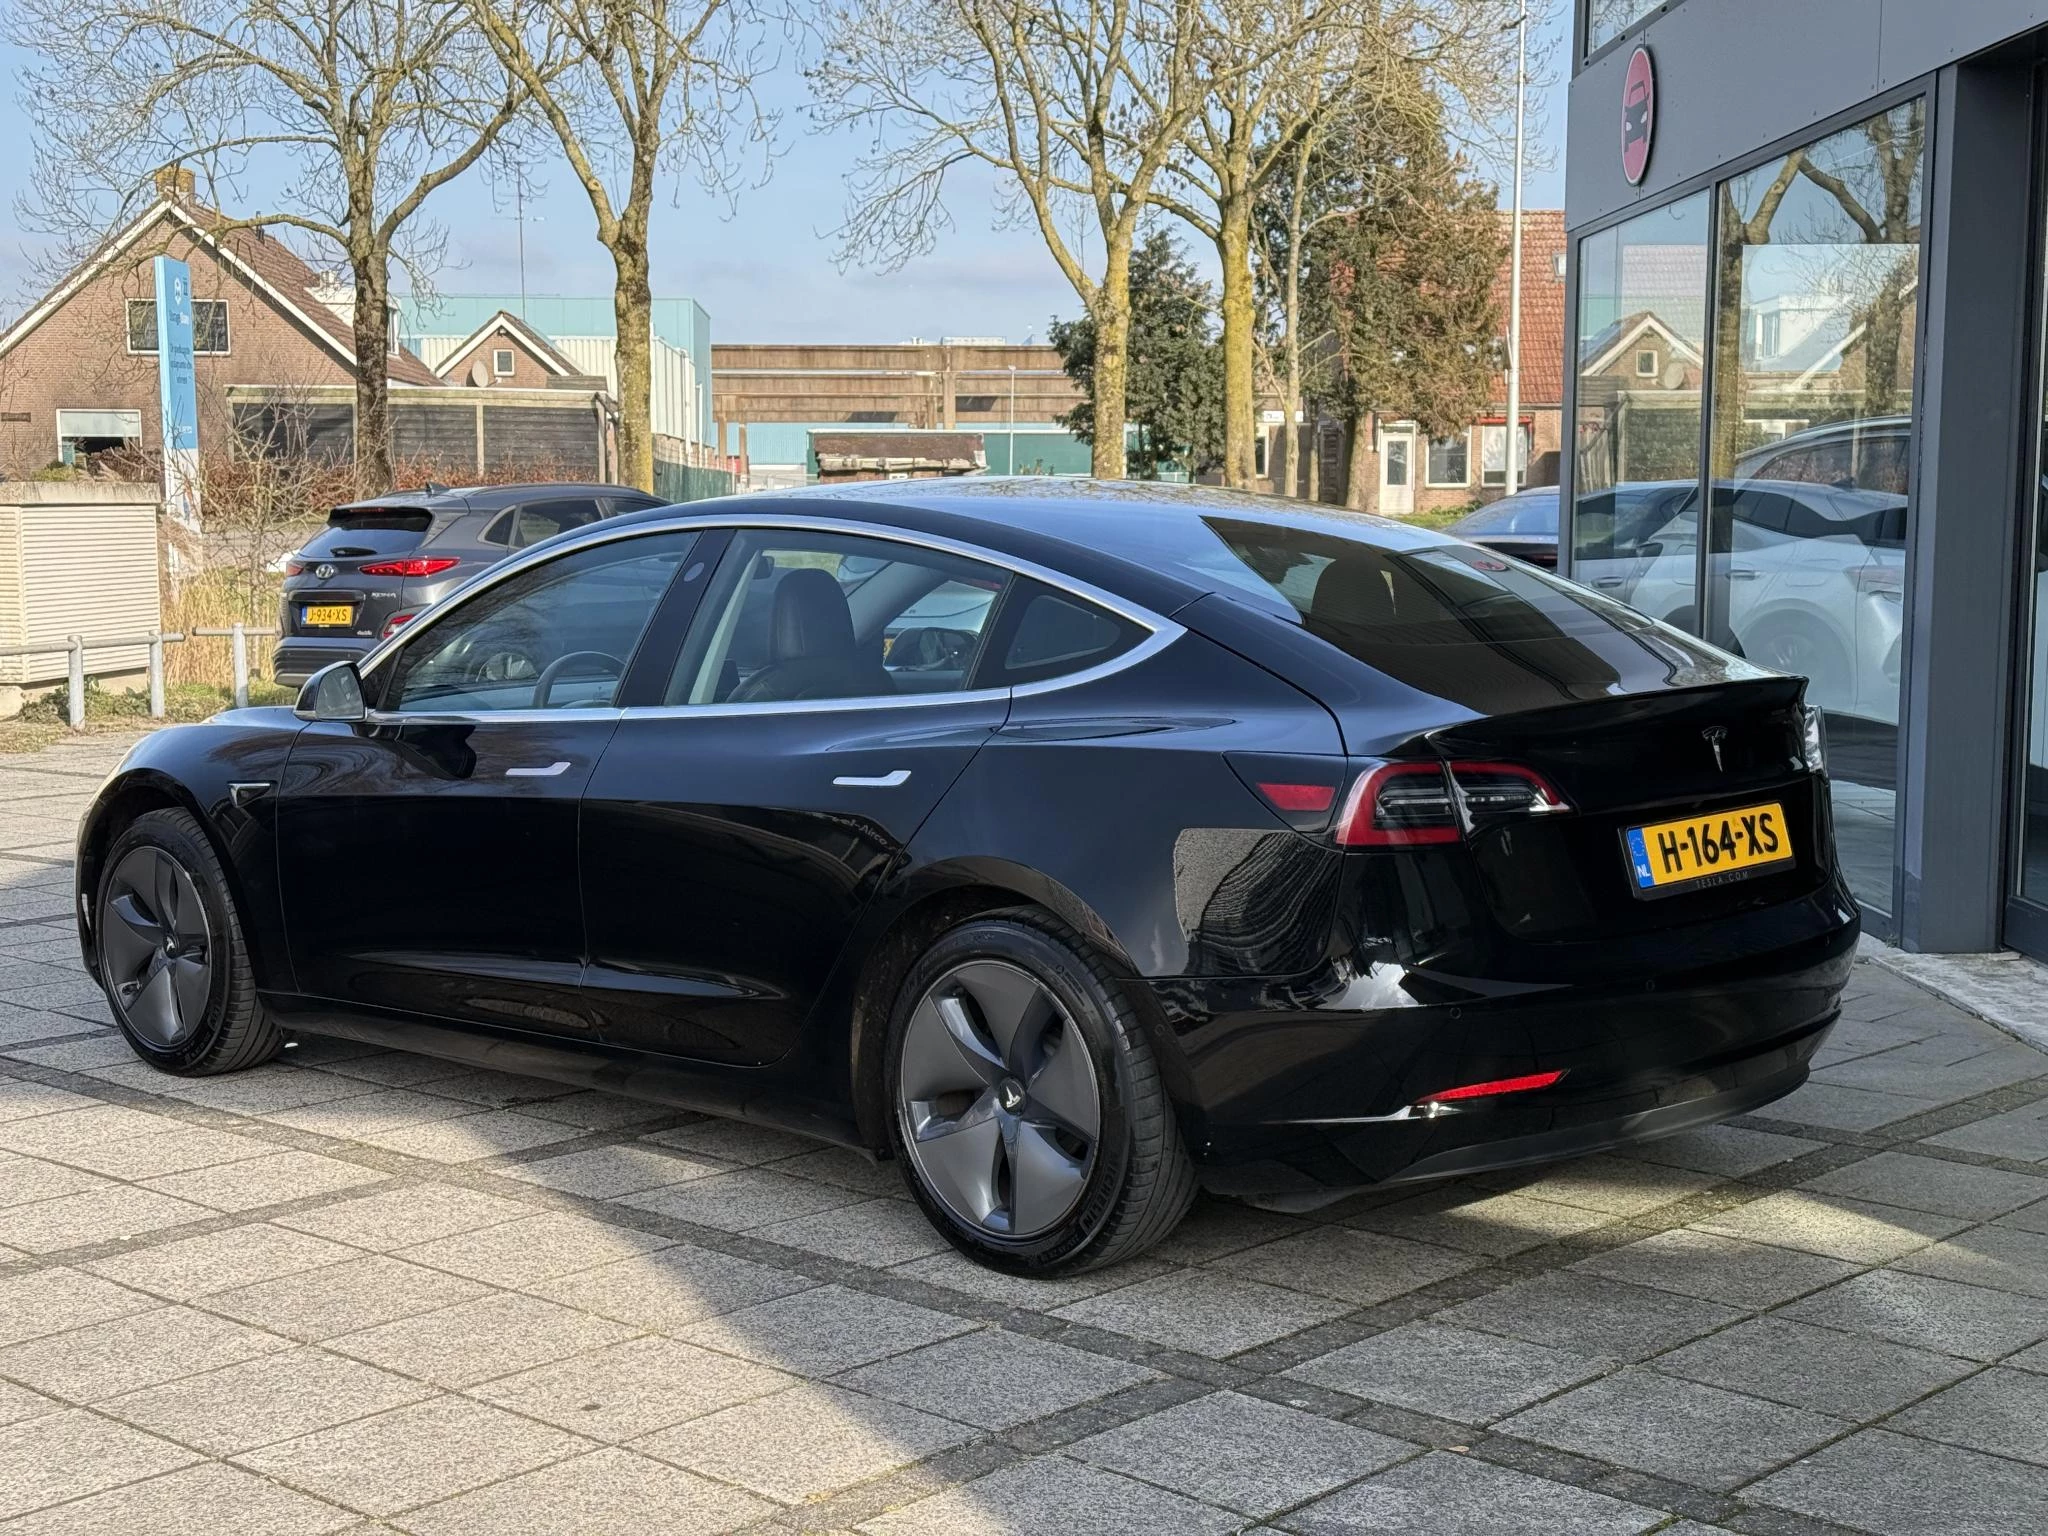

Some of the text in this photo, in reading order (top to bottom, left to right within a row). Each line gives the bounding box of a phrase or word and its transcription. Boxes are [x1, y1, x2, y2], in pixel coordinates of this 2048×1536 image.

[308, 608, 348, 623] J-934-XS
[1657, 812, 1779, 875] H-164-XS
[1636, 864, 1651, 878] NL
